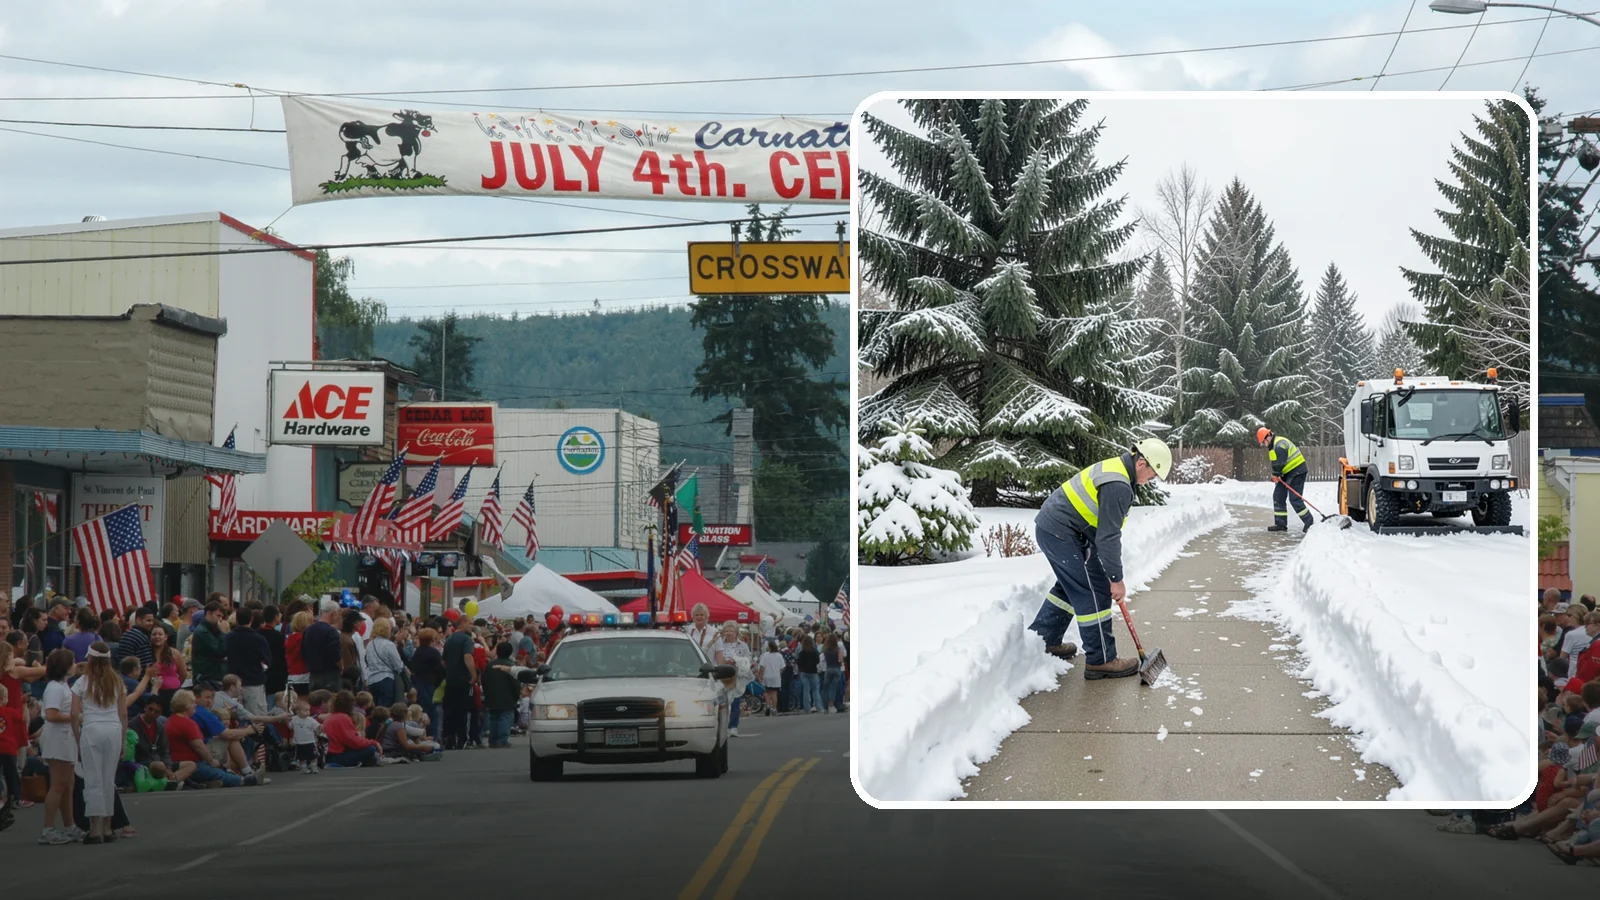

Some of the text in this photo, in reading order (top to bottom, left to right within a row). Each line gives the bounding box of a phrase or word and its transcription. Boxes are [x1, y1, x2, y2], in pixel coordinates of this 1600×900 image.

[695, 121, 850, 149] Carnat
[481, 141, 605, 192] JULY
[632, 150, 747, 198] 4th.
[697, 254, 850, 280] CROSSWA
[283, 380, 373, 420] ACE
[405, 409, 453, 422] CEDAR
[283, 421, 371, 436] Hardware
[416, 428, 477, 447] Coca-Cola
[353, 467, 386, 480] Simpl
[96, 485, 124, 495] Vincent
[126, 485, 136, 495] de
[138, 485, 155, 495] Paul
[688, 527, 742, 535] CRNATION
[699, 535, 730, 543] GLASS
